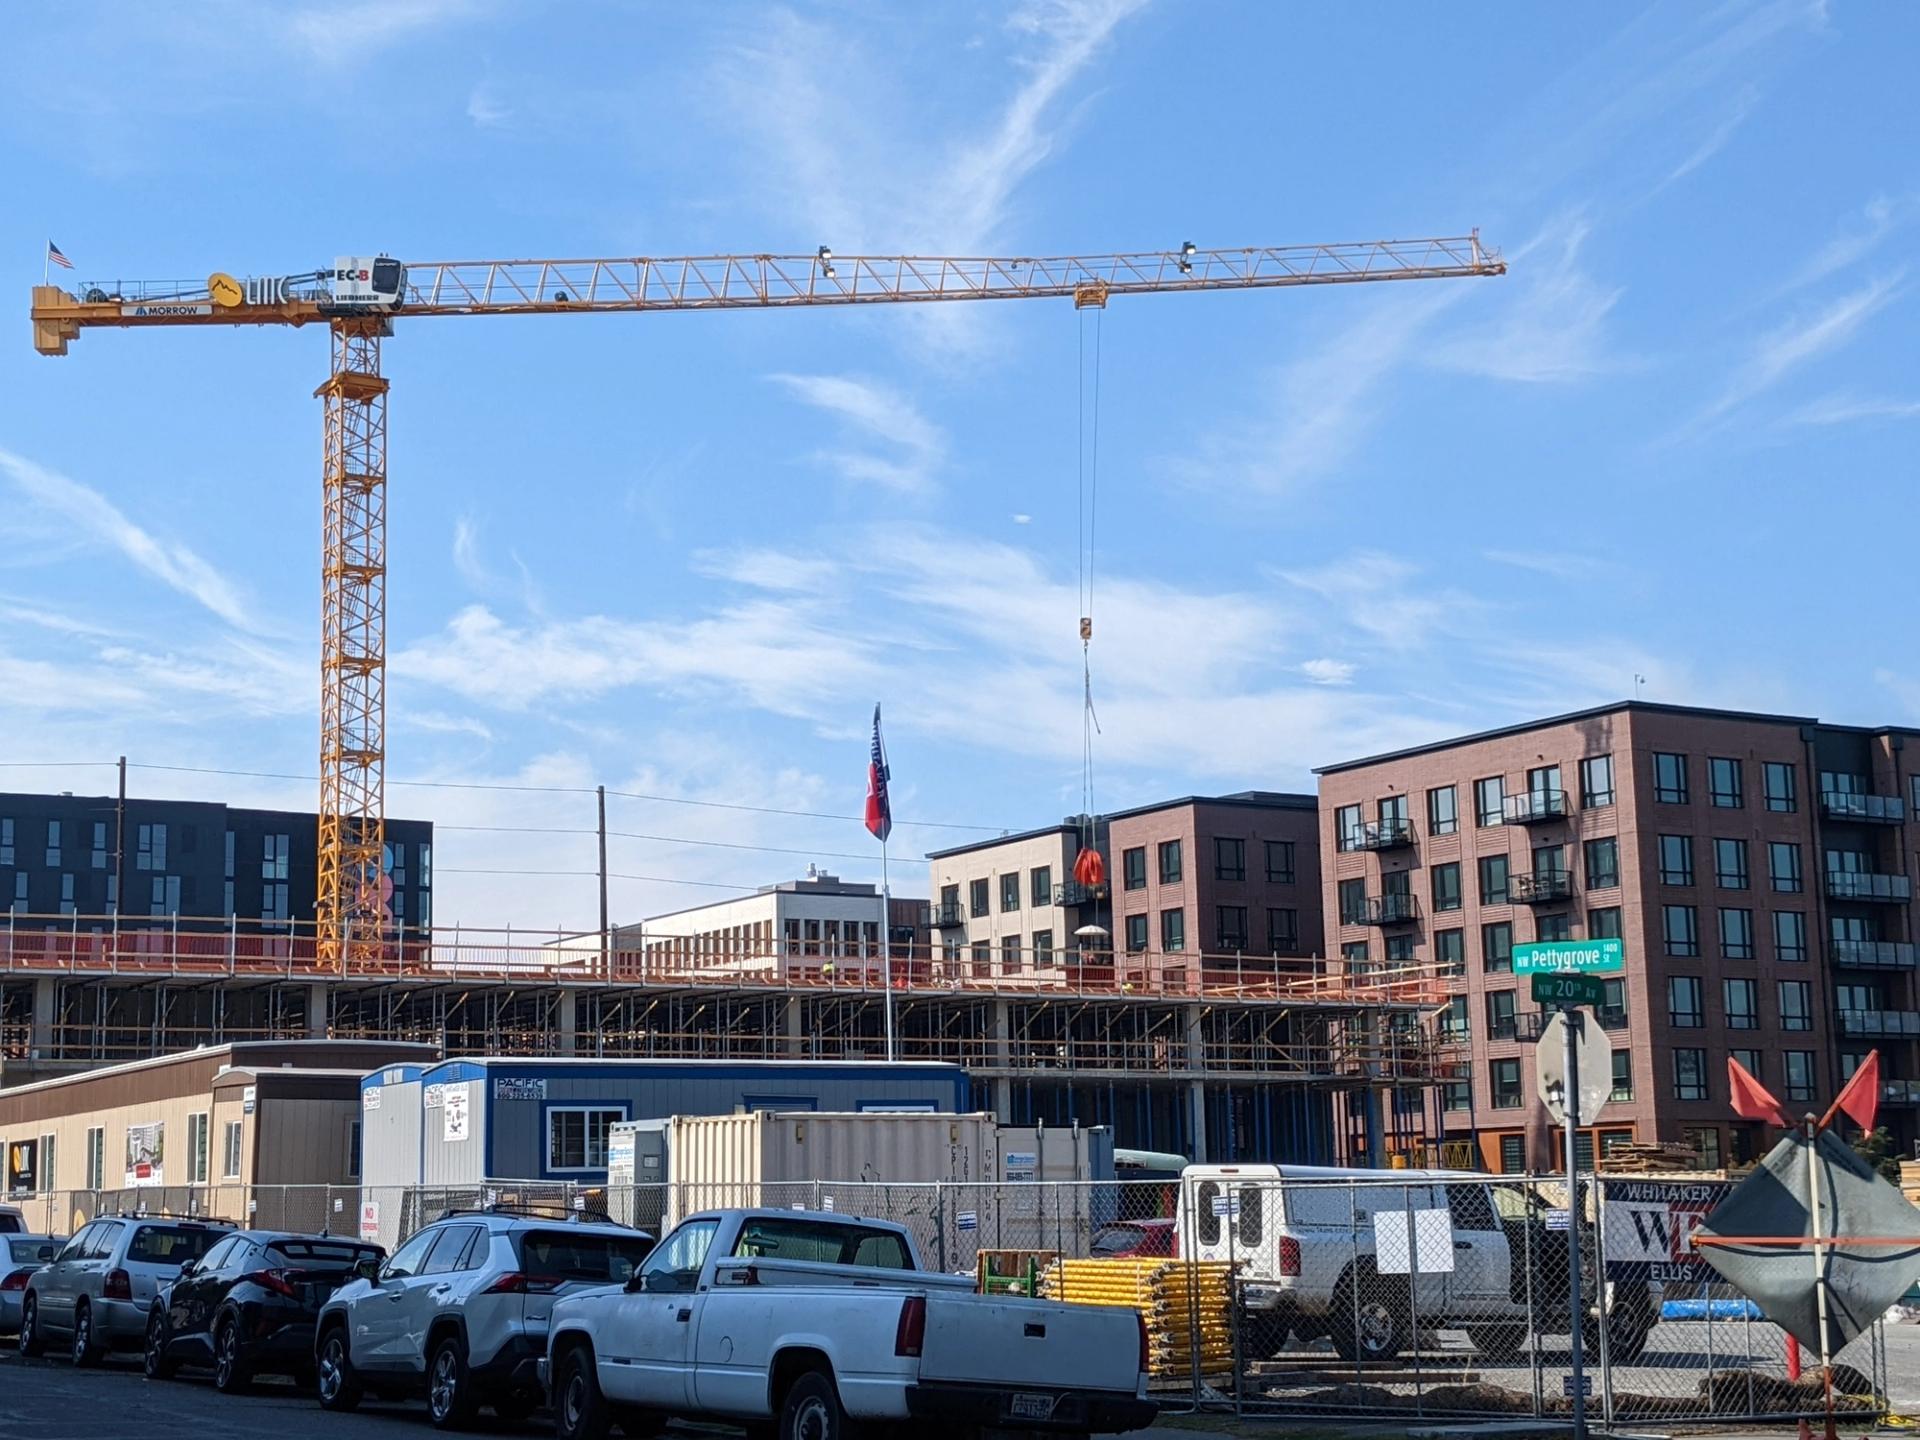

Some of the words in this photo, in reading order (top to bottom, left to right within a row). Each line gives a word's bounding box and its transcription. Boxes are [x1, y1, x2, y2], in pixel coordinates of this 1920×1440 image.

[337, 269, 369, 281] EC-B
[246, 276, 290, 305] LMC
[149, 306, 198, 315] MORROW
[1517, 956, 1529, 968] NW
[1531, 949, 1600, 969] Pettygrove
[1538, 984, 1552, 996] NW
[497, 1078, 543, 1088] PACIFIC
[1626, 1183, 1711, 1201] WHITAKER
[1651, 1264, 1692, 1280] ELLIS
